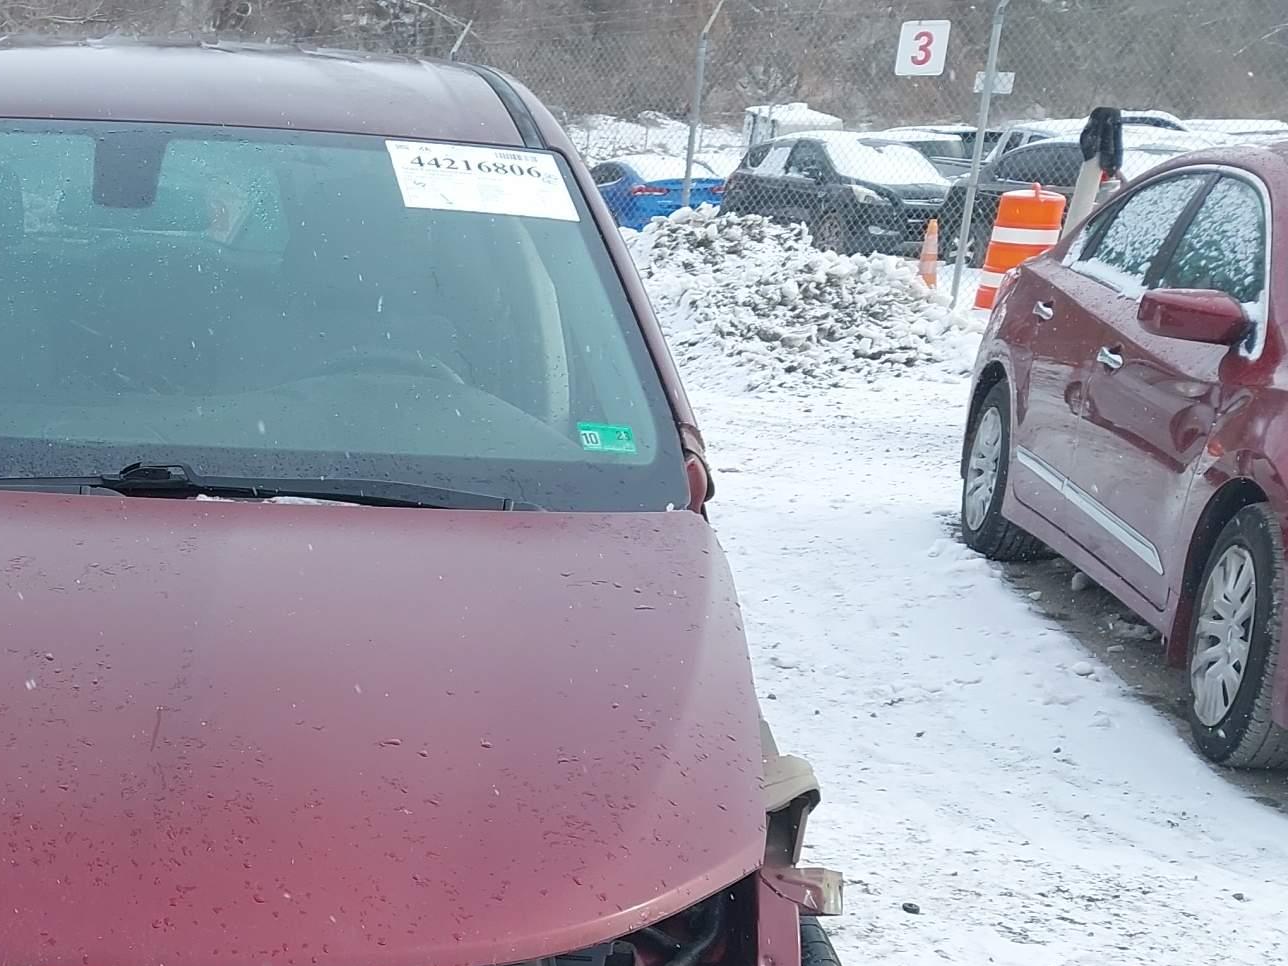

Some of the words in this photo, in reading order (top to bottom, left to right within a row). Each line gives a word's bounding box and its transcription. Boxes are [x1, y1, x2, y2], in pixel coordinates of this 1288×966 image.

[911, 31, 934, 66] 3
[410, 155, 542, 178] 44216806
[581, 432, 600, 445] 10
